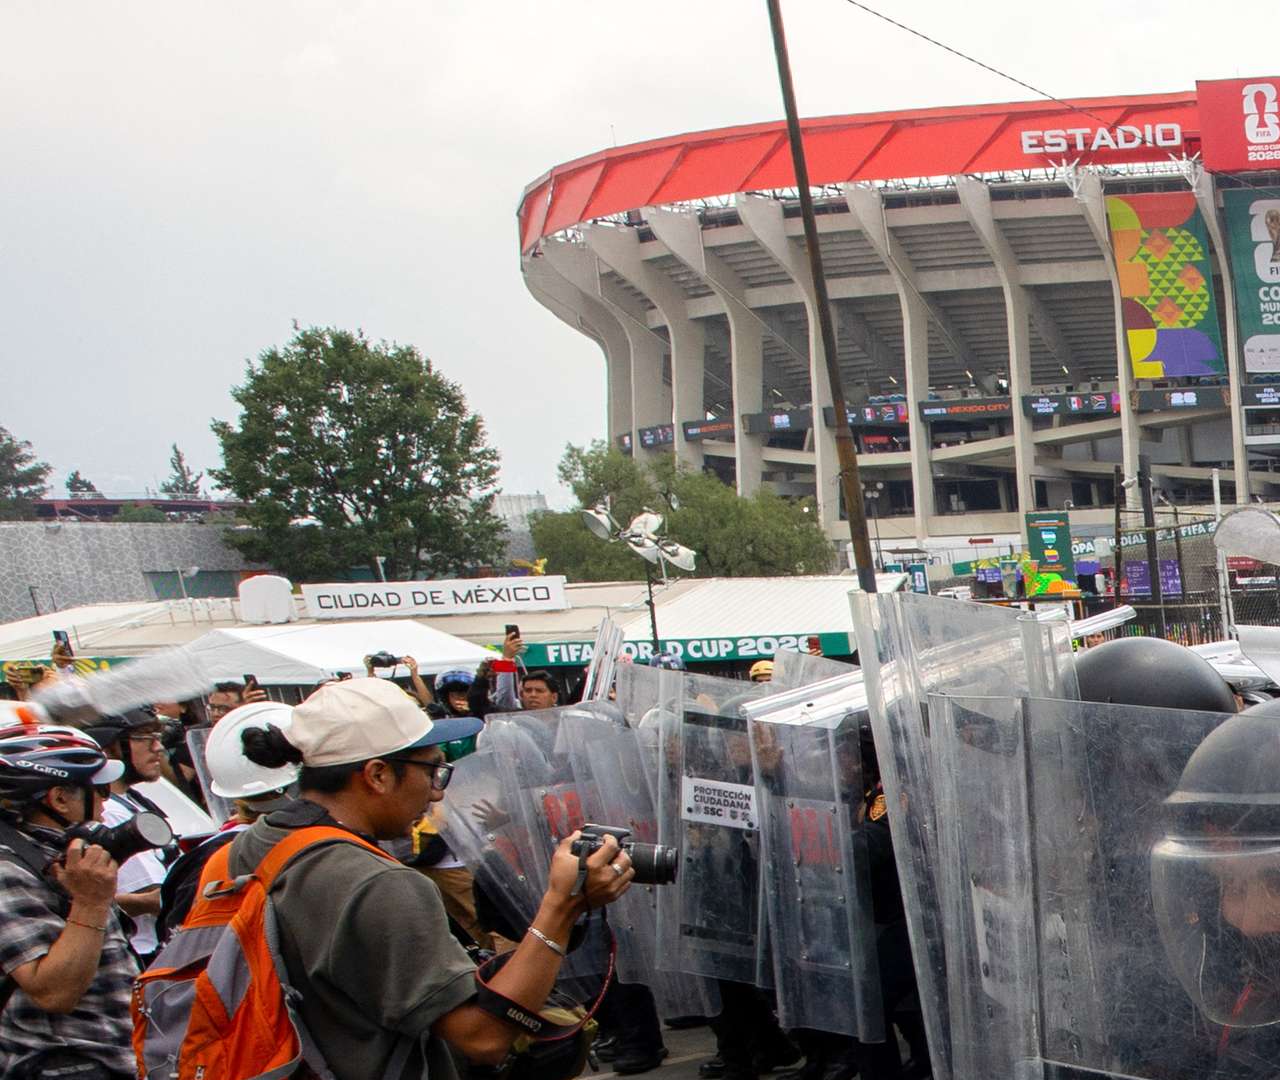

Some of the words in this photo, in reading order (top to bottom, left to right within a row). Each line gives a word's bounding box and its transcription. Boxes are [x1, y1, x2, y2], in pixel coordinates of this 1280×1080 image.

[1021, 123, 1182, 154] ESTADIO
[1255, 130, 1272, 138] FIFA
[1071, 540, 1095, 554] OPA
[1181, 523, 1206, 536] FIFA
[317, 591, 401, 609] CIUDAD
[412, 590, 445, 606] DE
[452, 584, 550, 605] MÉXICO
[546, 644, 594, 663] FIFA
[686, 639, 734, 658] CUP
[33, 763, 70, 778] GIRO
[694, 785, 752, 802] PROTECCIÓN
[693, 795, 752, 811] CIUDADANA
[703, 806, 724, 817] SSC
